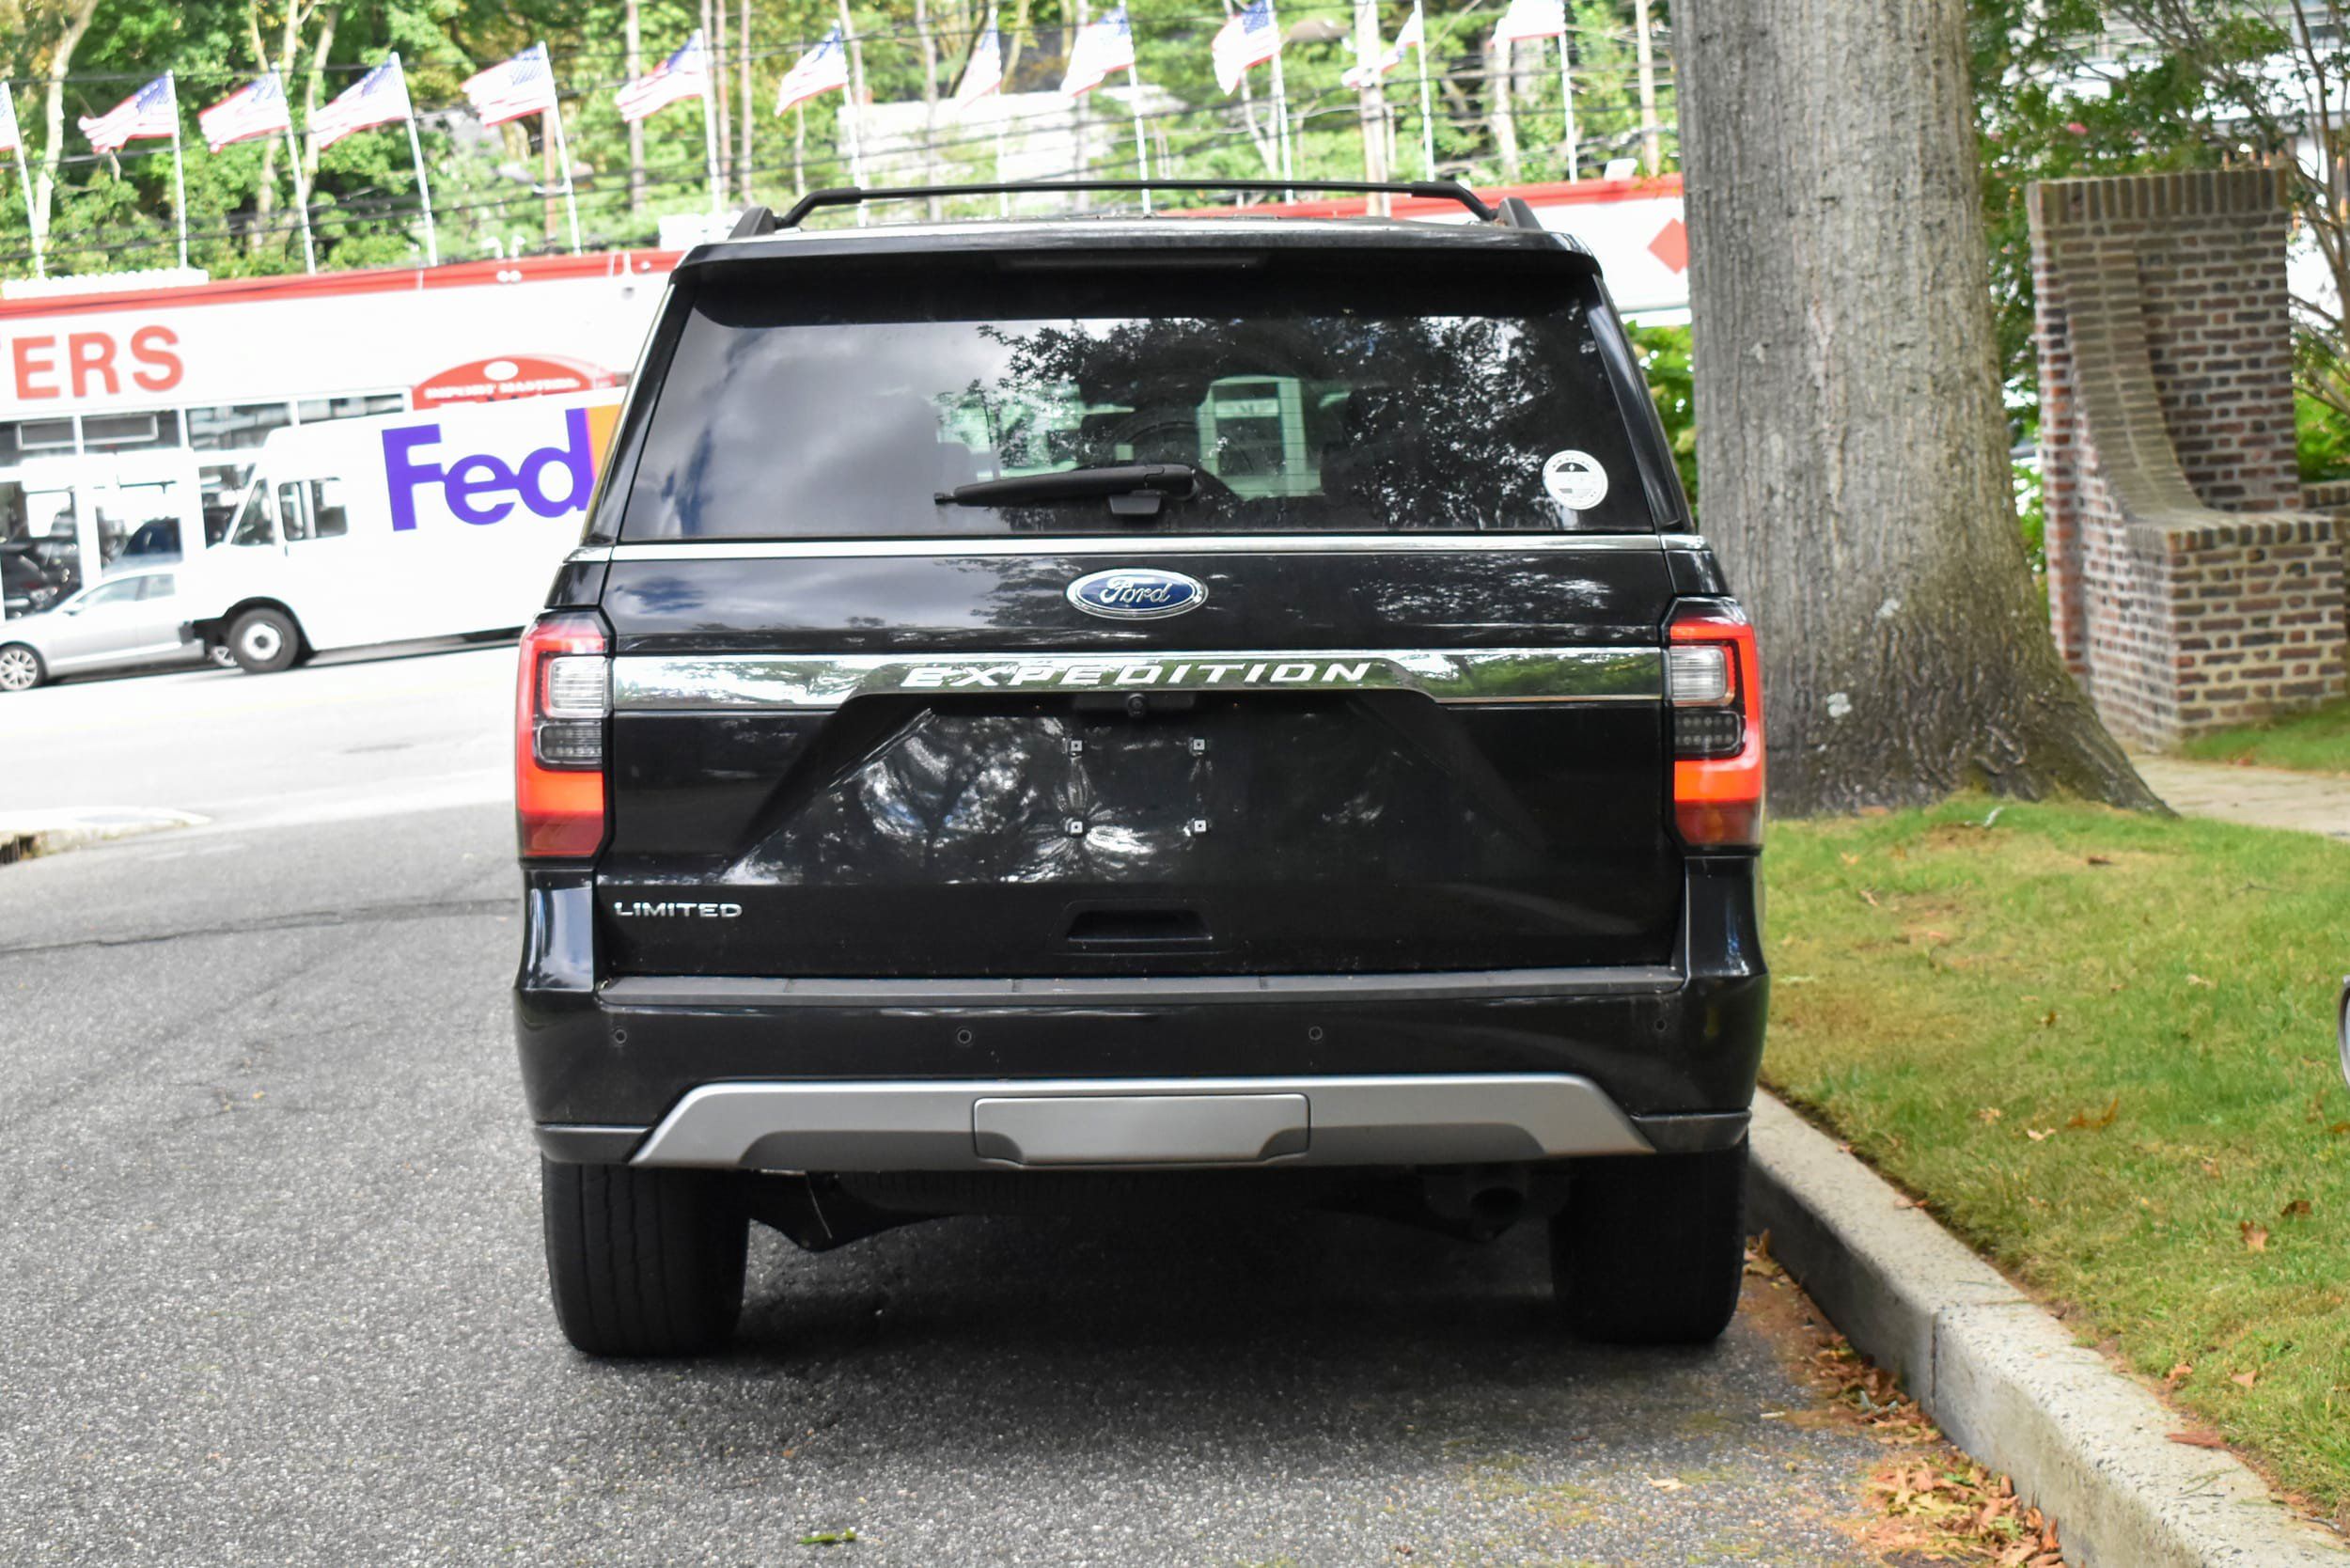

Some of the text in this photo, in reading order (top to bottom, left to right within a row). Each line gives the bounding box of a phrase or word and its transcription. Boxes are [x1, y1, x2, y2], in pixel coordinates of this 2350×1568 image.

[0, 324, 184, 400] ERS
[382, 404, 621, 532] Fed
[1100, 575, 1173, 604] Ford
[900, 662, 1371, 687] EXPEDITION
[614, 902, 743, 917] LIMITED
